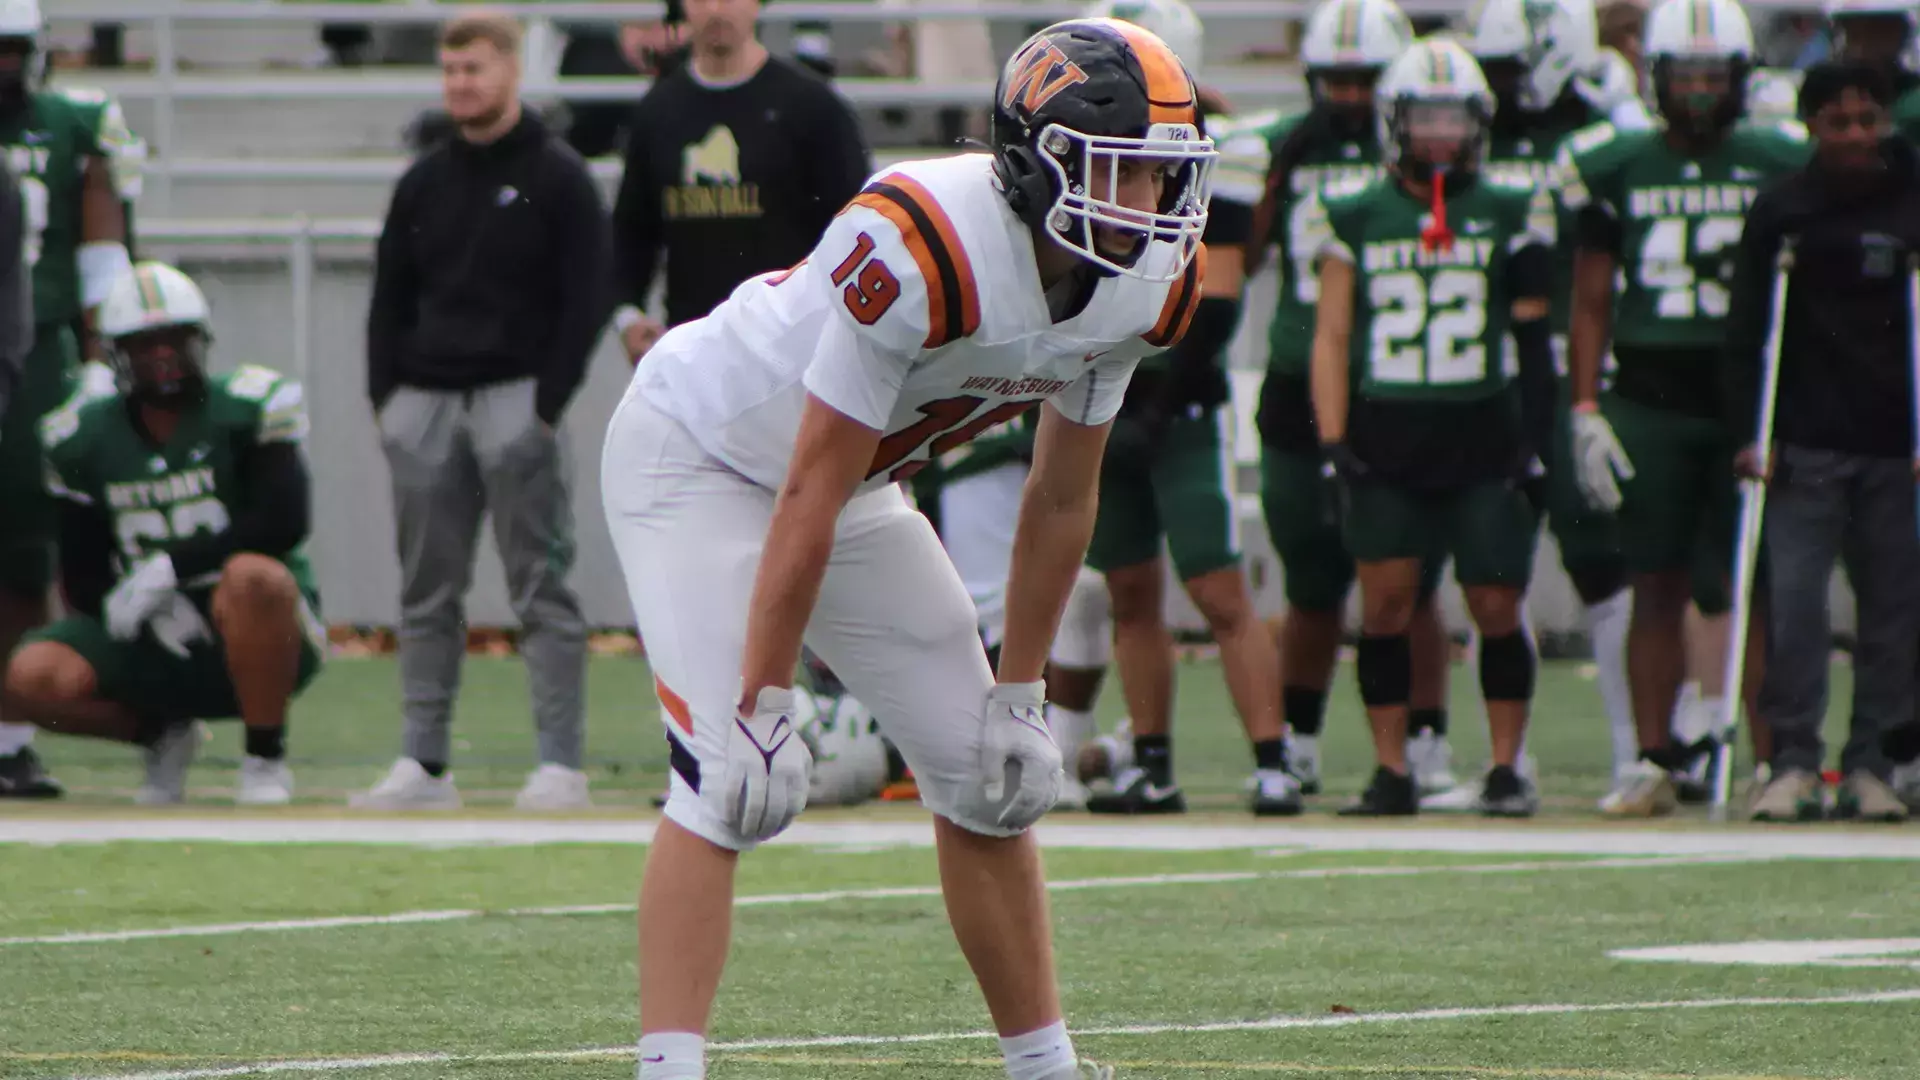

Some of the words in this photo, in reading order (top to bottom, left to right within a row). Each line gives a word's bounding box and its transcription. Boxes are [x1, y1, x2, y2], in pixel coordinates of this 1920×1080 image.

[1004, 35, 1090, 115] W
[1168, 127, 1189, 141] 724
[830, 231, 901, 325] 19
[1370, 269, 1488, 384] 22
